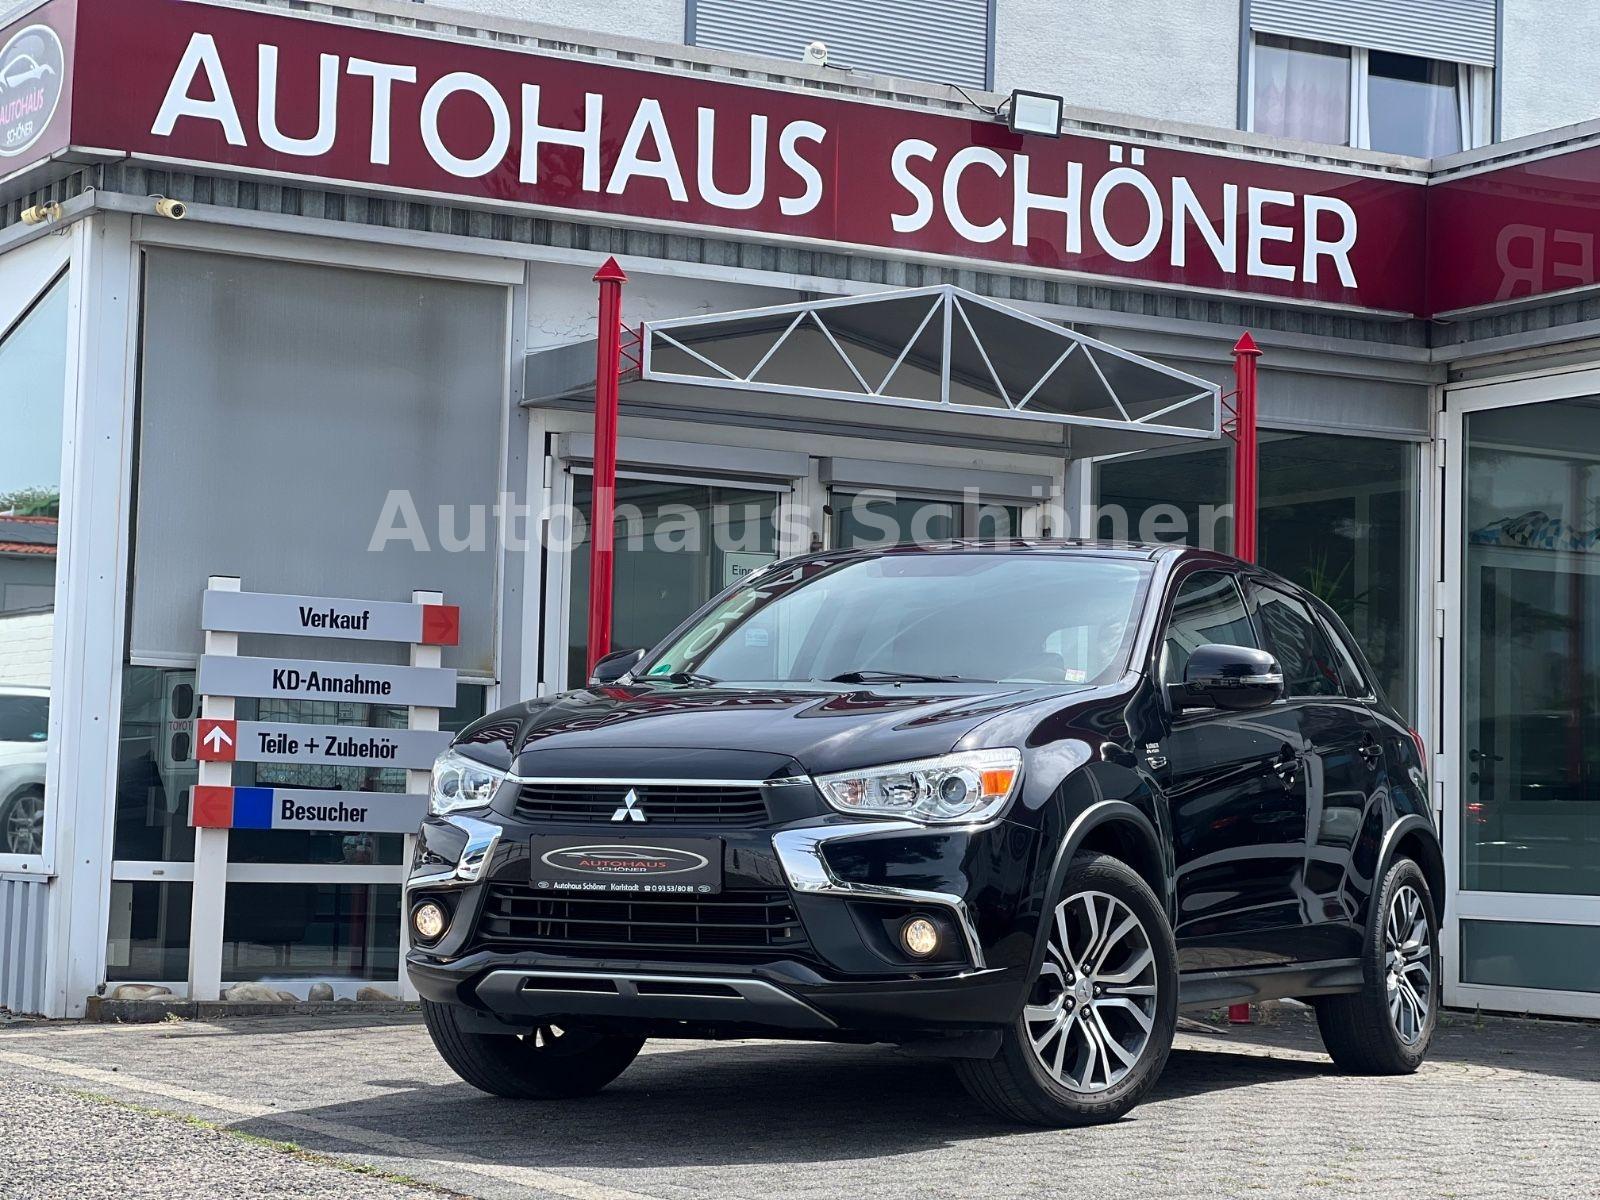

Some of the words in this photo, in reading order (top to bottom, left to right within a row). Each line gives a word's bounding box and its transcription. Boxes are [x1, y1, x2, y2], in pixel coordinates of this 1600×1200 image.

[0, 88, 44, 125] AUTOHAUS
[6, 121, 33, 144] SCHÖNER
[151, 31, 828, 216] AUTOHAUS
[890, 138, 1359, 289] SCHÖNER
[299, 606, 370, 631] Verkauf
[272, 668, 392, 695] KD-Annahme
[168, 720, 193, 731] TOYOT
[257, 732, 299, 754] Teile
[304, 737, 320, 754] +
[324, 735, 399, 759] Zubehör
[280, 799, 368, 822] Besucher
[579, 859, 667, 868] AUTOHAUS
[553, 881, 582, 890] Autohaus
[582, 882, 607, 891] Schöner
[610, 883, 639, 892] Karlstadt
